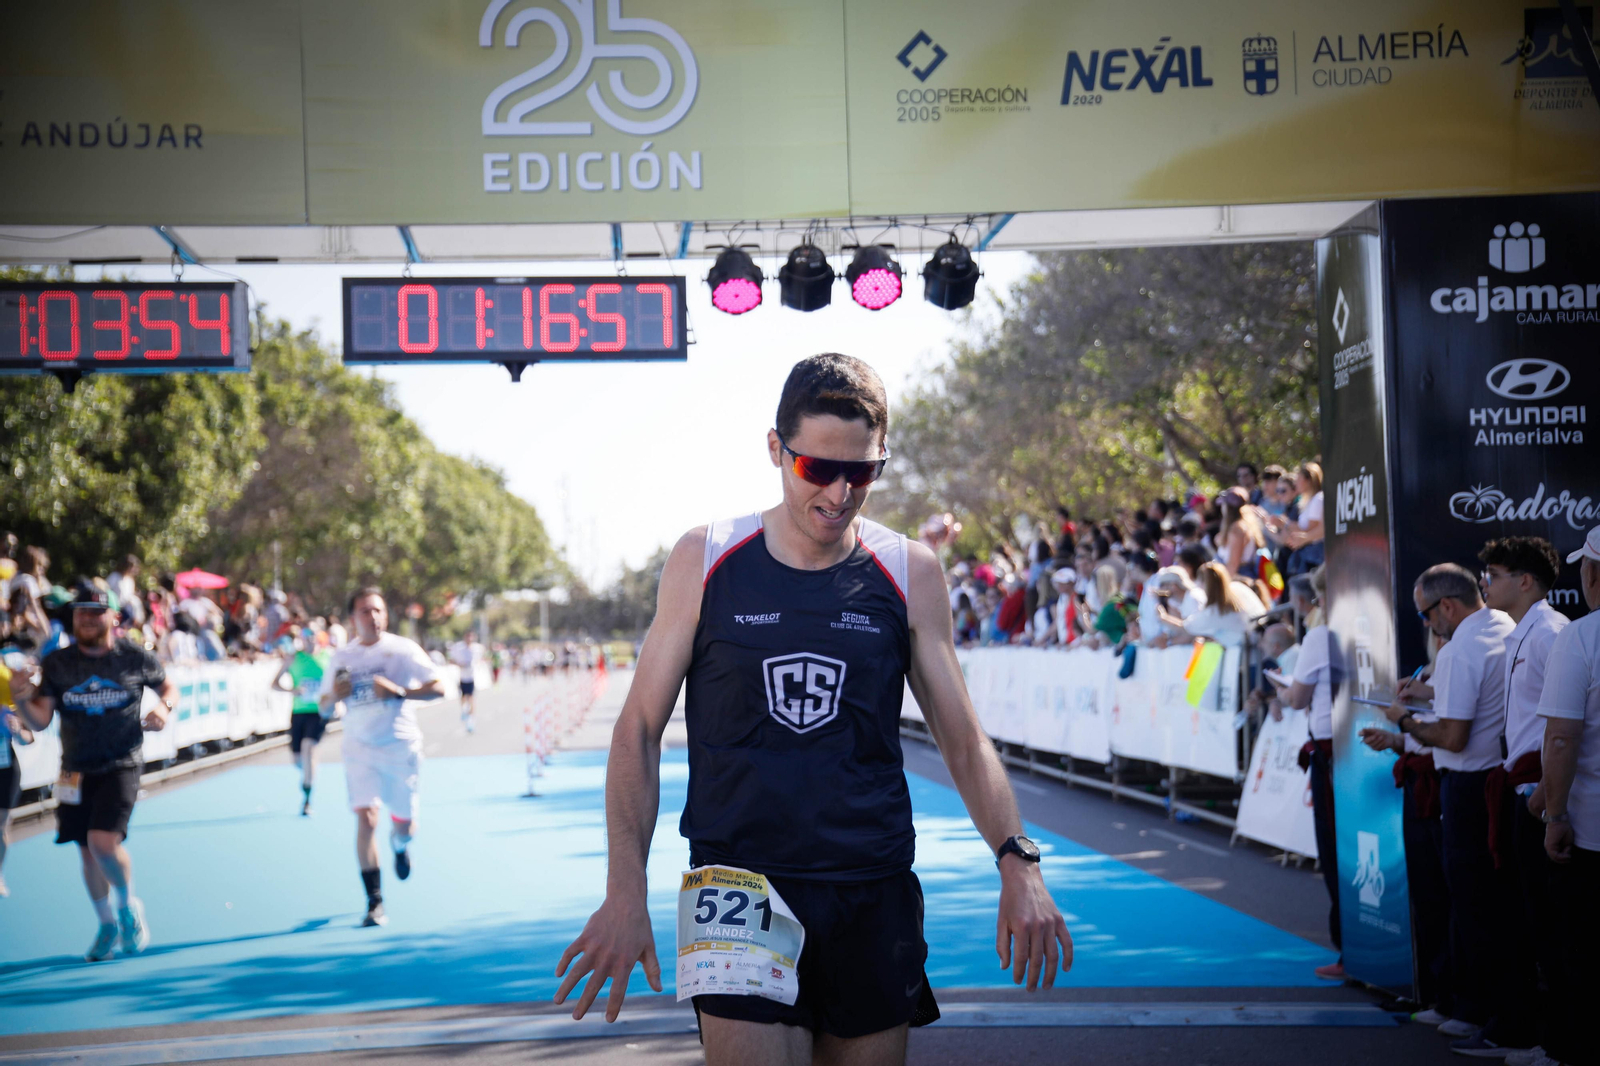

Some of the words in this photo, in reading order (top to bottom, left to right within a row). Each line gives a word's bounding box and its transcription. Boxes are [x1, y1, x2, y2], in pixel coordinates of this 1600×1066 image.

[1313, 23, 1469, 63] ALMERÍA
[479, 0, 699, 136] 25
[1060, 36, 1214, 106] NEXAL
[1312, 66, 1393, 87] CIUDAD
[896, 84, 1029, 105] COOPERACIÓN
[1072, 94, 1103, 106] 2020
[897, 106, 941, 123] 2005
[20, 117, 205, 148] ANDÚJAR
[483, 142, 704, 191] EDICIÓN
[1430, 276, 1600, 324] cajamar
[397, 284, 673, 352] 01:16:57
[1516, 312, 1553, 325] CAJA
[1556, 311, 1600, 323] RURAL
[1469, 405, 1587, 427] HYUNDAI
[1474, 428, 1584, 447] Almerialva
[745, 612, 781, 622] TAKELOT
[841, 612, 870, 625] SEGURA
[711, 875, 742, 886] Almería
[742, 880, 764, 890] 2024
[694, 888, 773, 933] 521
[705, 926, 755, 940] NANDEZ
